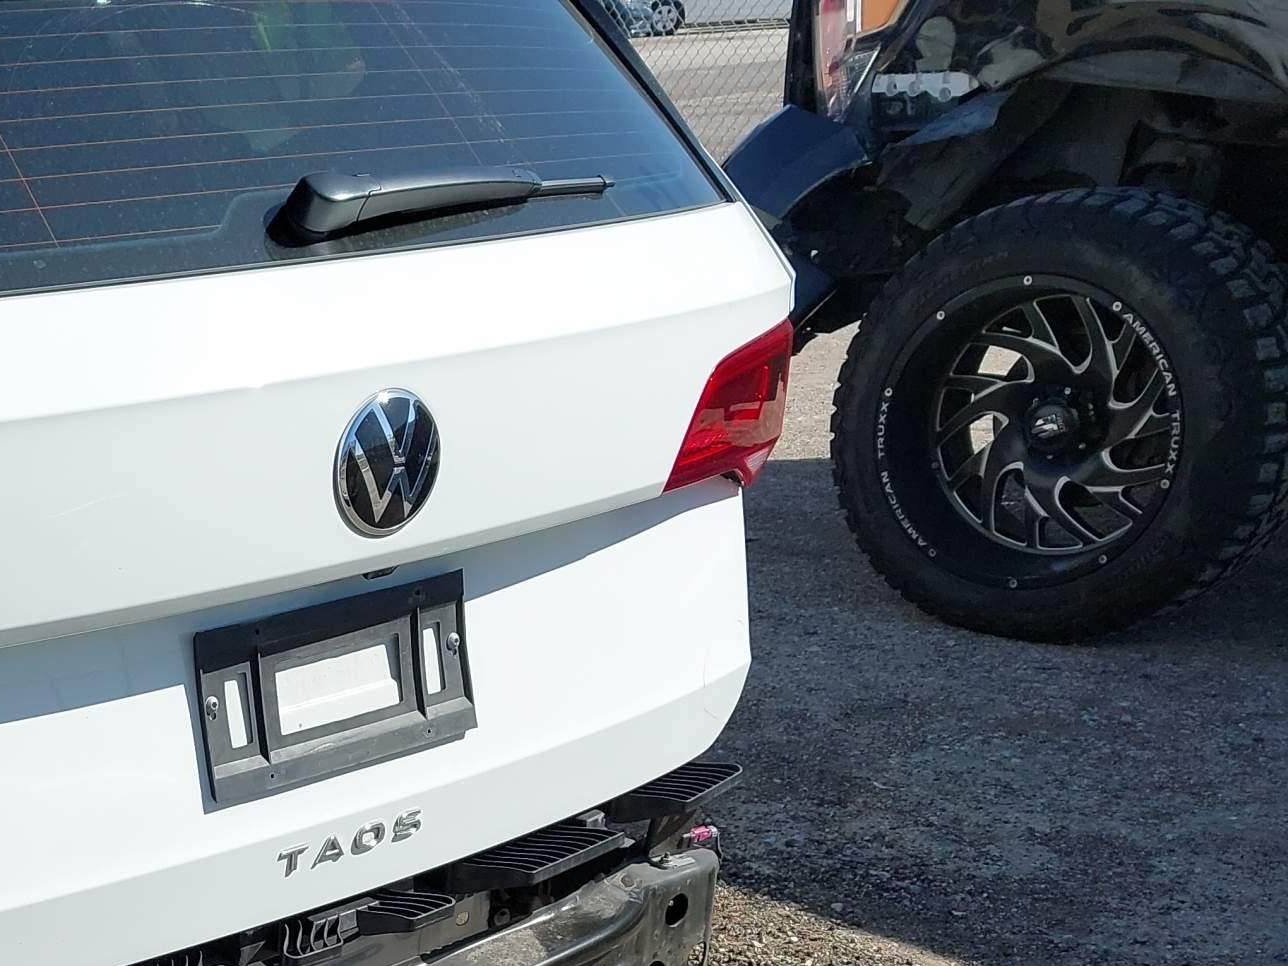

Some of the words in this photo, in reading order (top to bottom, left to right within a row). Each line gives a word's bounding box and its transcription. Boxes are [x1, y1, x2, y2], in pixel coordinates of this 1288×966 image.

[1122, 312, 1177, 397] AMERICAN
[1163, 409, 1181, 474] TRUXX
[876, 401, 890, 460] TRUXX
[880, 471, 928, 547] AMERICAN
[276, 807, 423, 879] TAOS
